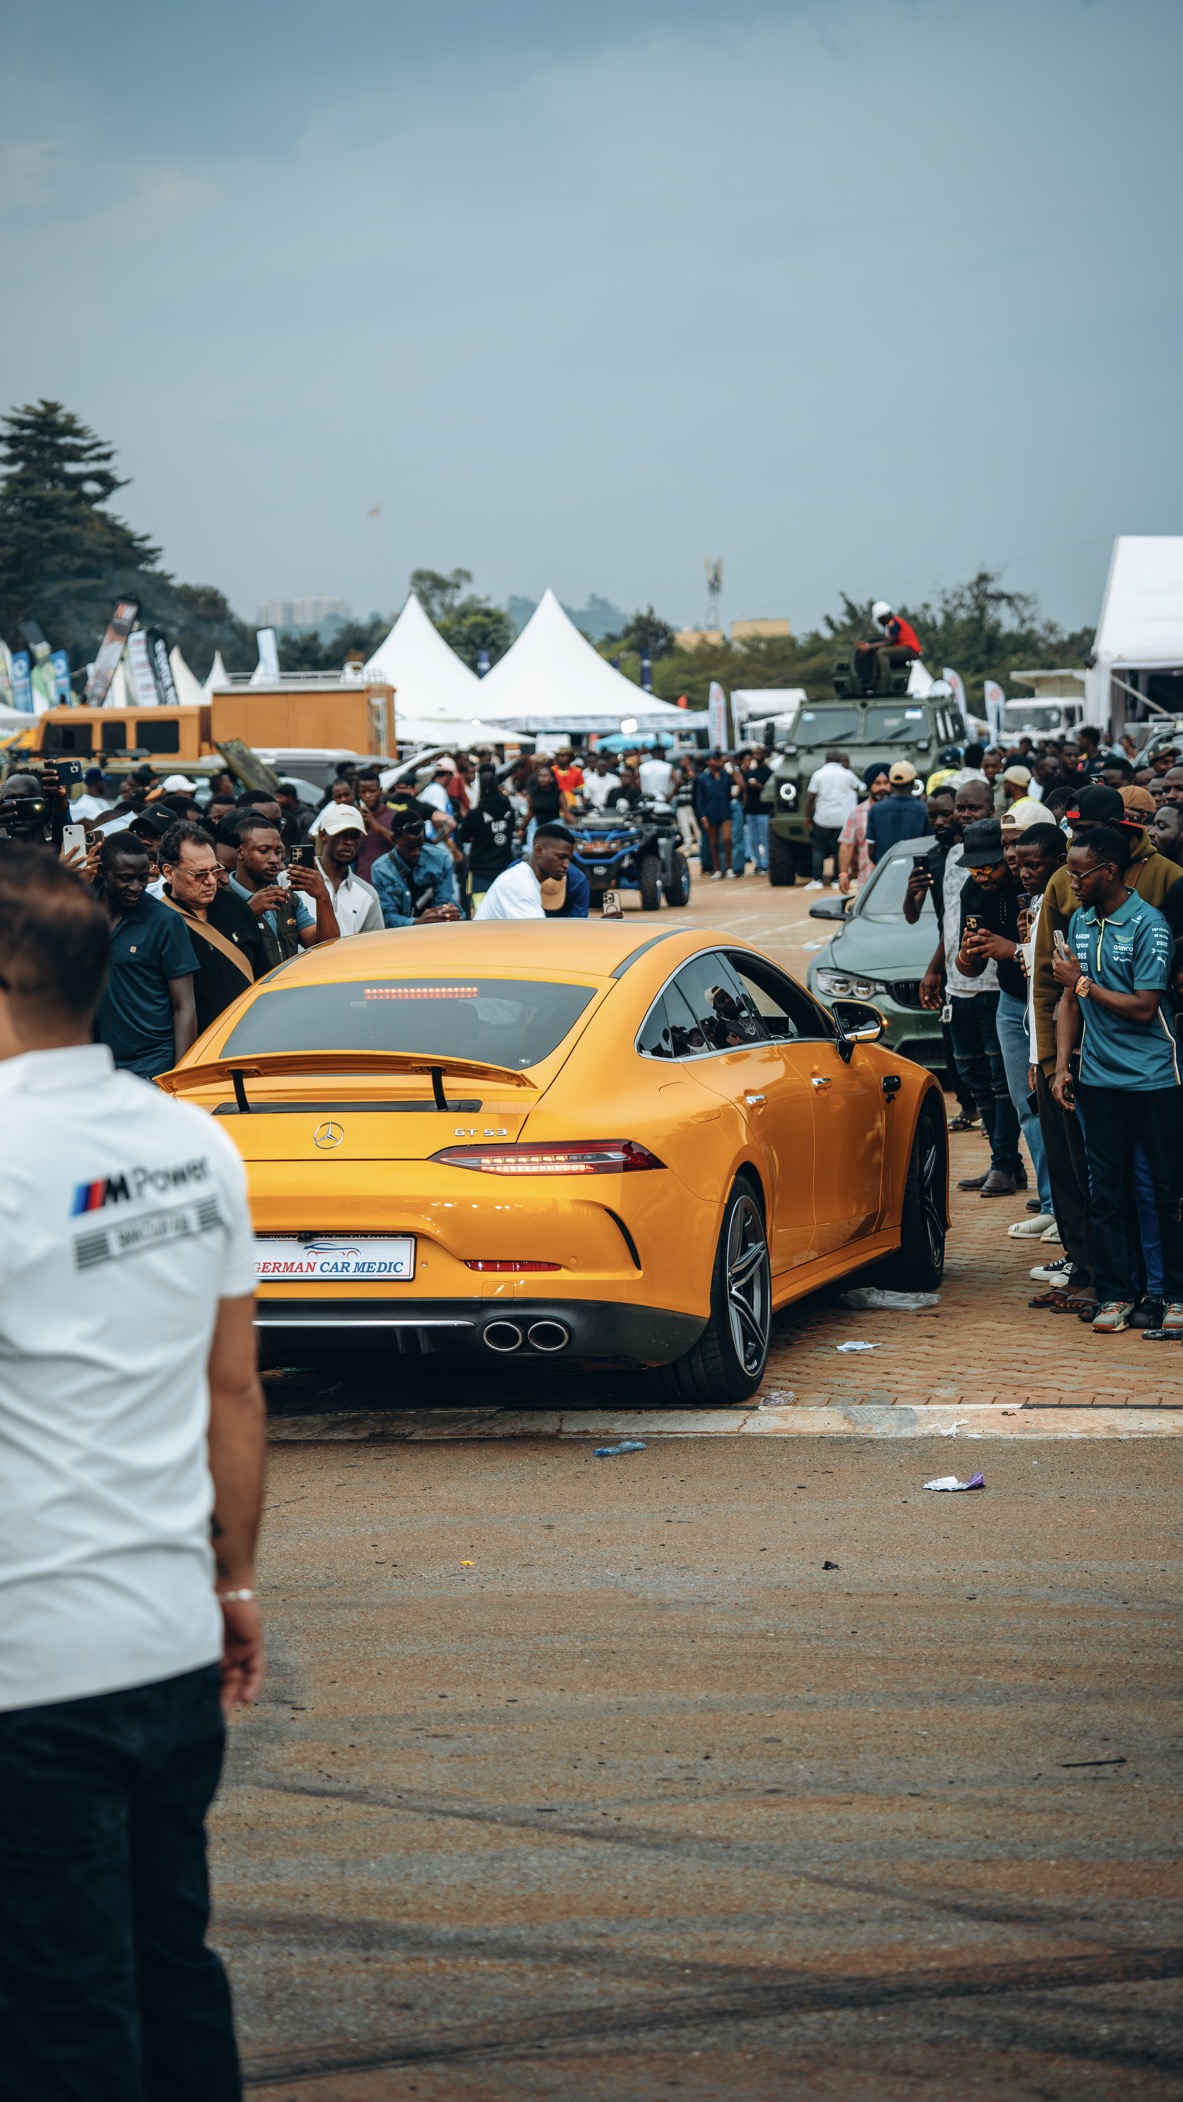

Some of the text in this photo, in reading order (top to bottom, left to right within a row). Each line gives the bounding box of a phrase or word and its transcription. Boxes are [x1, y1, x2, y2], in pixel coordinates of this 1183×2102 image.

[454, 1128, 507, 1137] GT 53
[132, 1156, 207, 1200] Power
[254, 1261, 404, 1273] GERMAN CAR MEDIC
